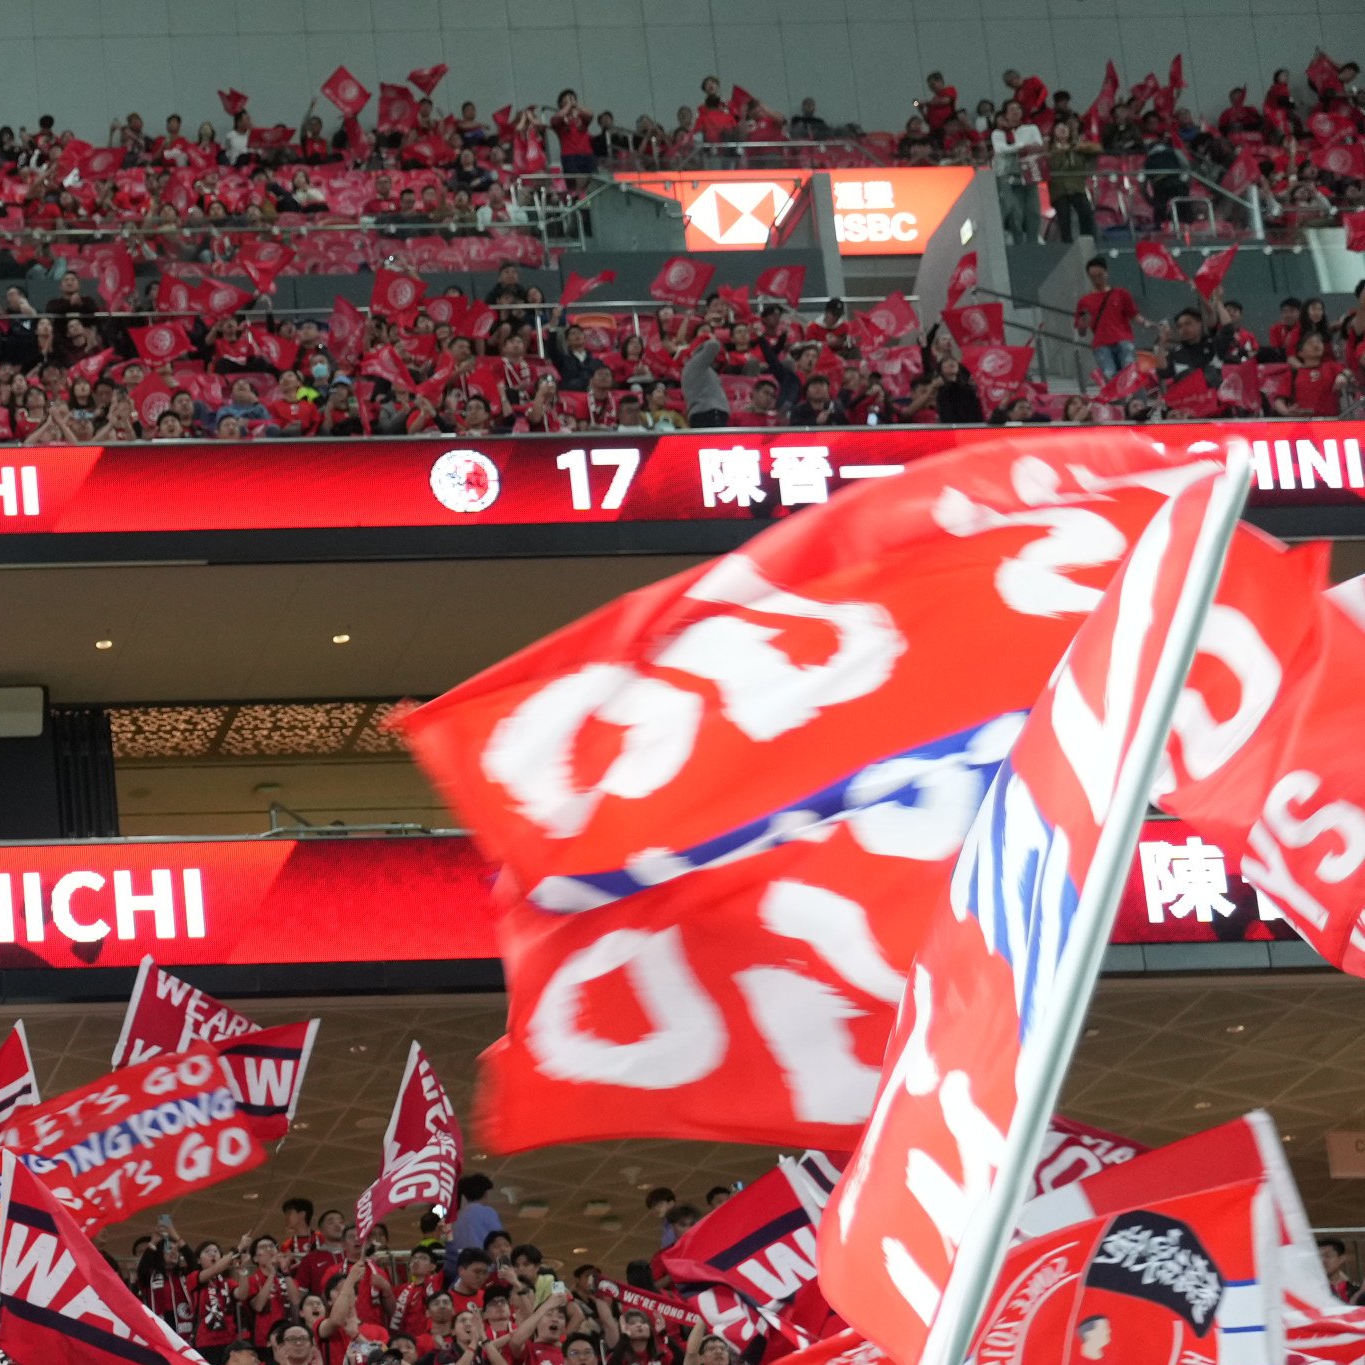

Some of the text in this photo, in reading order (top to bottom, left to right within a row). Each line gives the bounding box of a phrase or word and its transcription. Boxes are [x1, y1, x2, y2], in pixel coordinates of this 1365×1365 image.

[555, 448, 641, 510] 17
[698, 445, 905, 508] 陳晉一
[176, 1125, 252, 1182] GO
[623, 1289, 658, 1312] WE'RE
[657, 1301, 685, 1319] HONG
